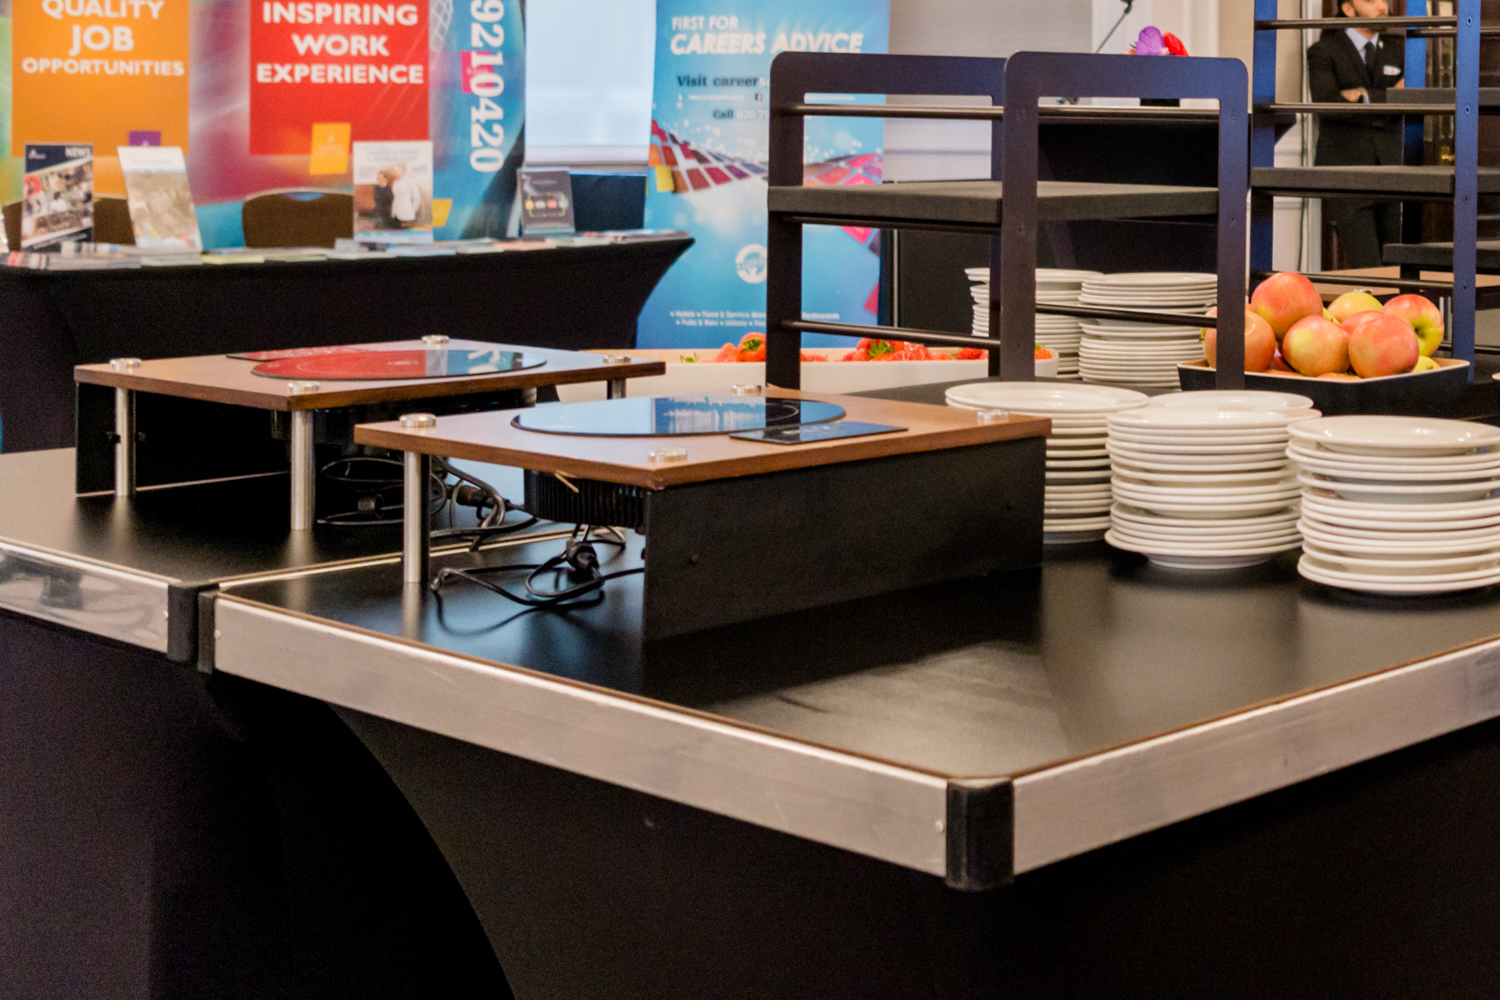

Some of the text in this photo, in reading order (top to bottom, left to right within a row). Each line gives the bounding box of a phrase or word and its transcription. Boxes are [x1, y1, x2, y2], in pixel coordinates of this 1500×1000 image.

[262, 1, 419, 26] INSPIRING
[671, 15, 738, 31] FIRST FOR
[68, 23, 135, 57] JOB
[291, 33, 390, 57] WORK
[670, 32, 864, 55] CAREERS ADVICE
[22, 57, 185, 77] OPPORTUNITIES
[256, 62, 424, 84] EXPERIENCE
[677, 75, 707, 87] Visit
[713, 110, 734, 119] Call
